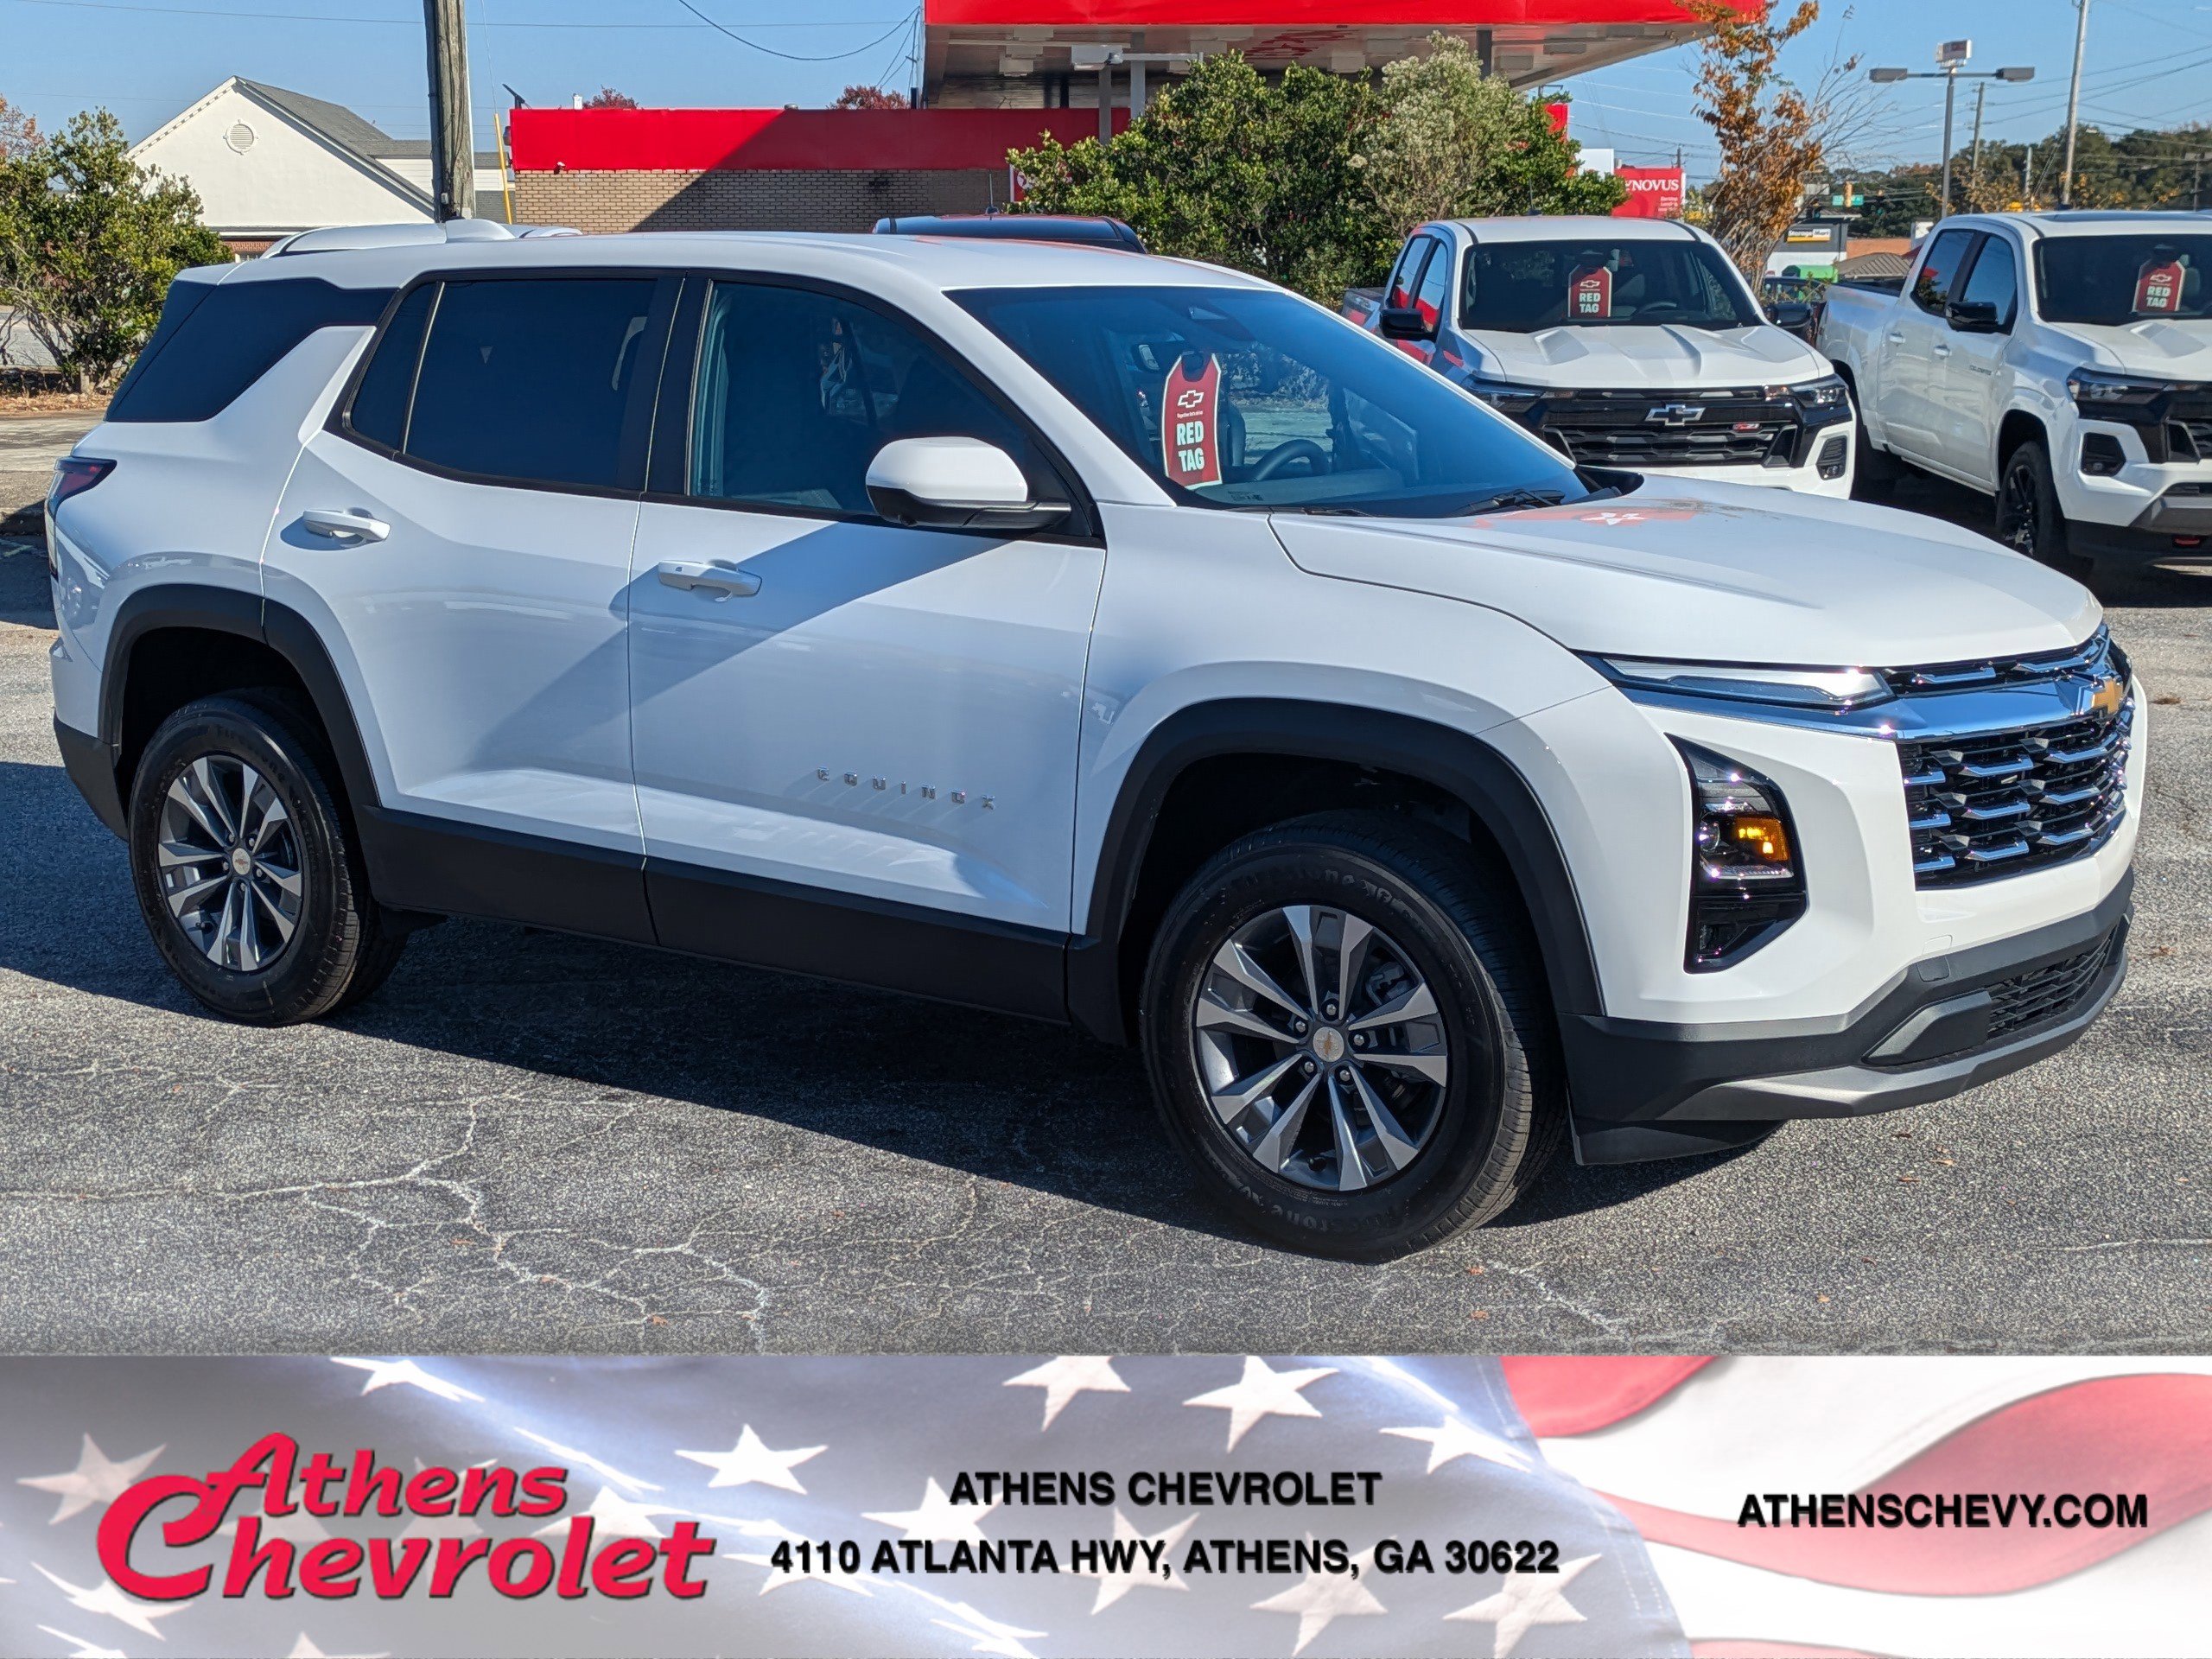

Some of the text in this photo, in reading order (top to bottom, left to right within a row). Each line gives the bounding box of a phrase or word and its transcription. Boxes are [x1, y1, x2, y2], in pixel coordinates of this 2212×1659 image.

[1625, 179, 1680, 191] YNOVUS
[1579, 292, 1601, 302] RED
[2146, 286, 2171, 296] RED
[1580, 303, 1599, 313] TAG
[2145, 296, 2167, 308] TAG
[1177, 421, 1205, 446] RED
[1178, 448, 1205, 473] TAG
[817, 766, 995, 810] EQUINOX
